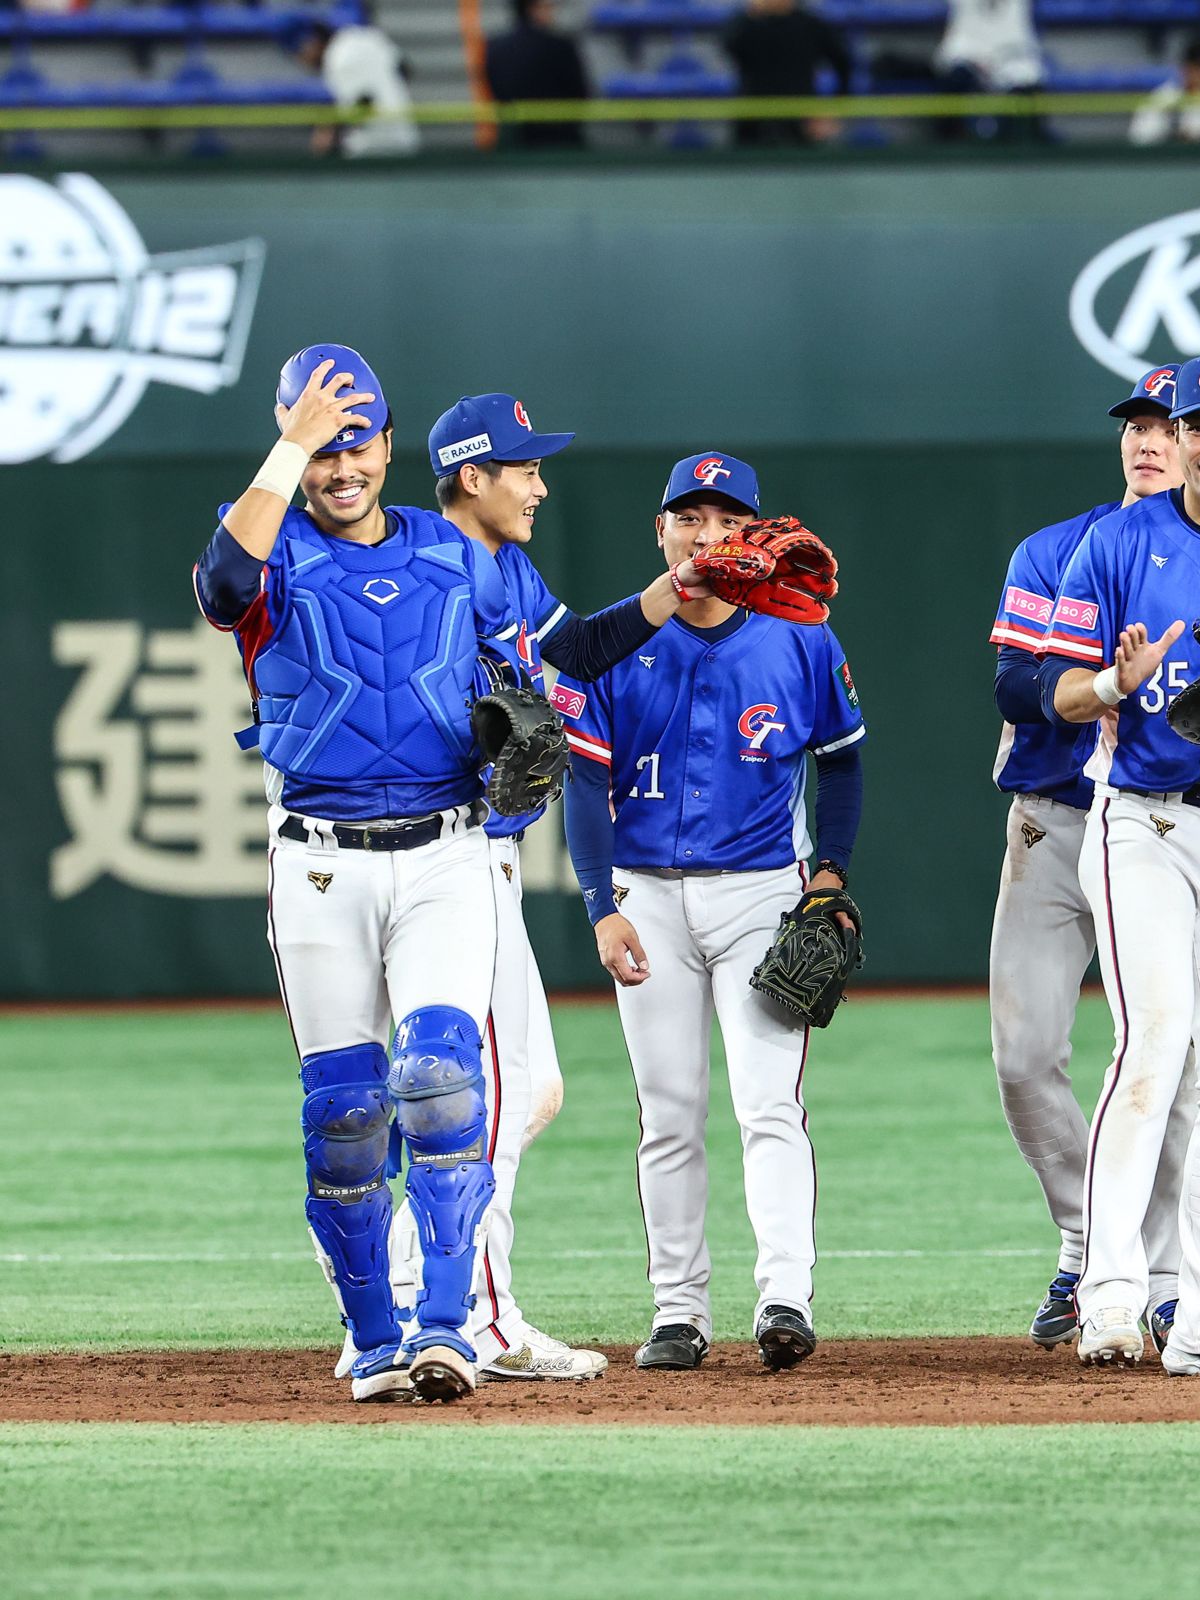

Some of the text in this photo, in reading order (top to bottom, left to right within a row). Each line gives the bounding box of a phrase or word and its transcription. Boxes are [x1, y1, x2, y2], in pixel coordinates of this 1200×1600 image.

[451, 438, 489, 459] RAXUS
[1140, 662, 1189, 713] 35
[415, 1151, 478, 1162] EVOSHIELD
[318, 1182, 379, 1196] EVOSHIELD
[497, 1347, 575, 1373] Angeles
